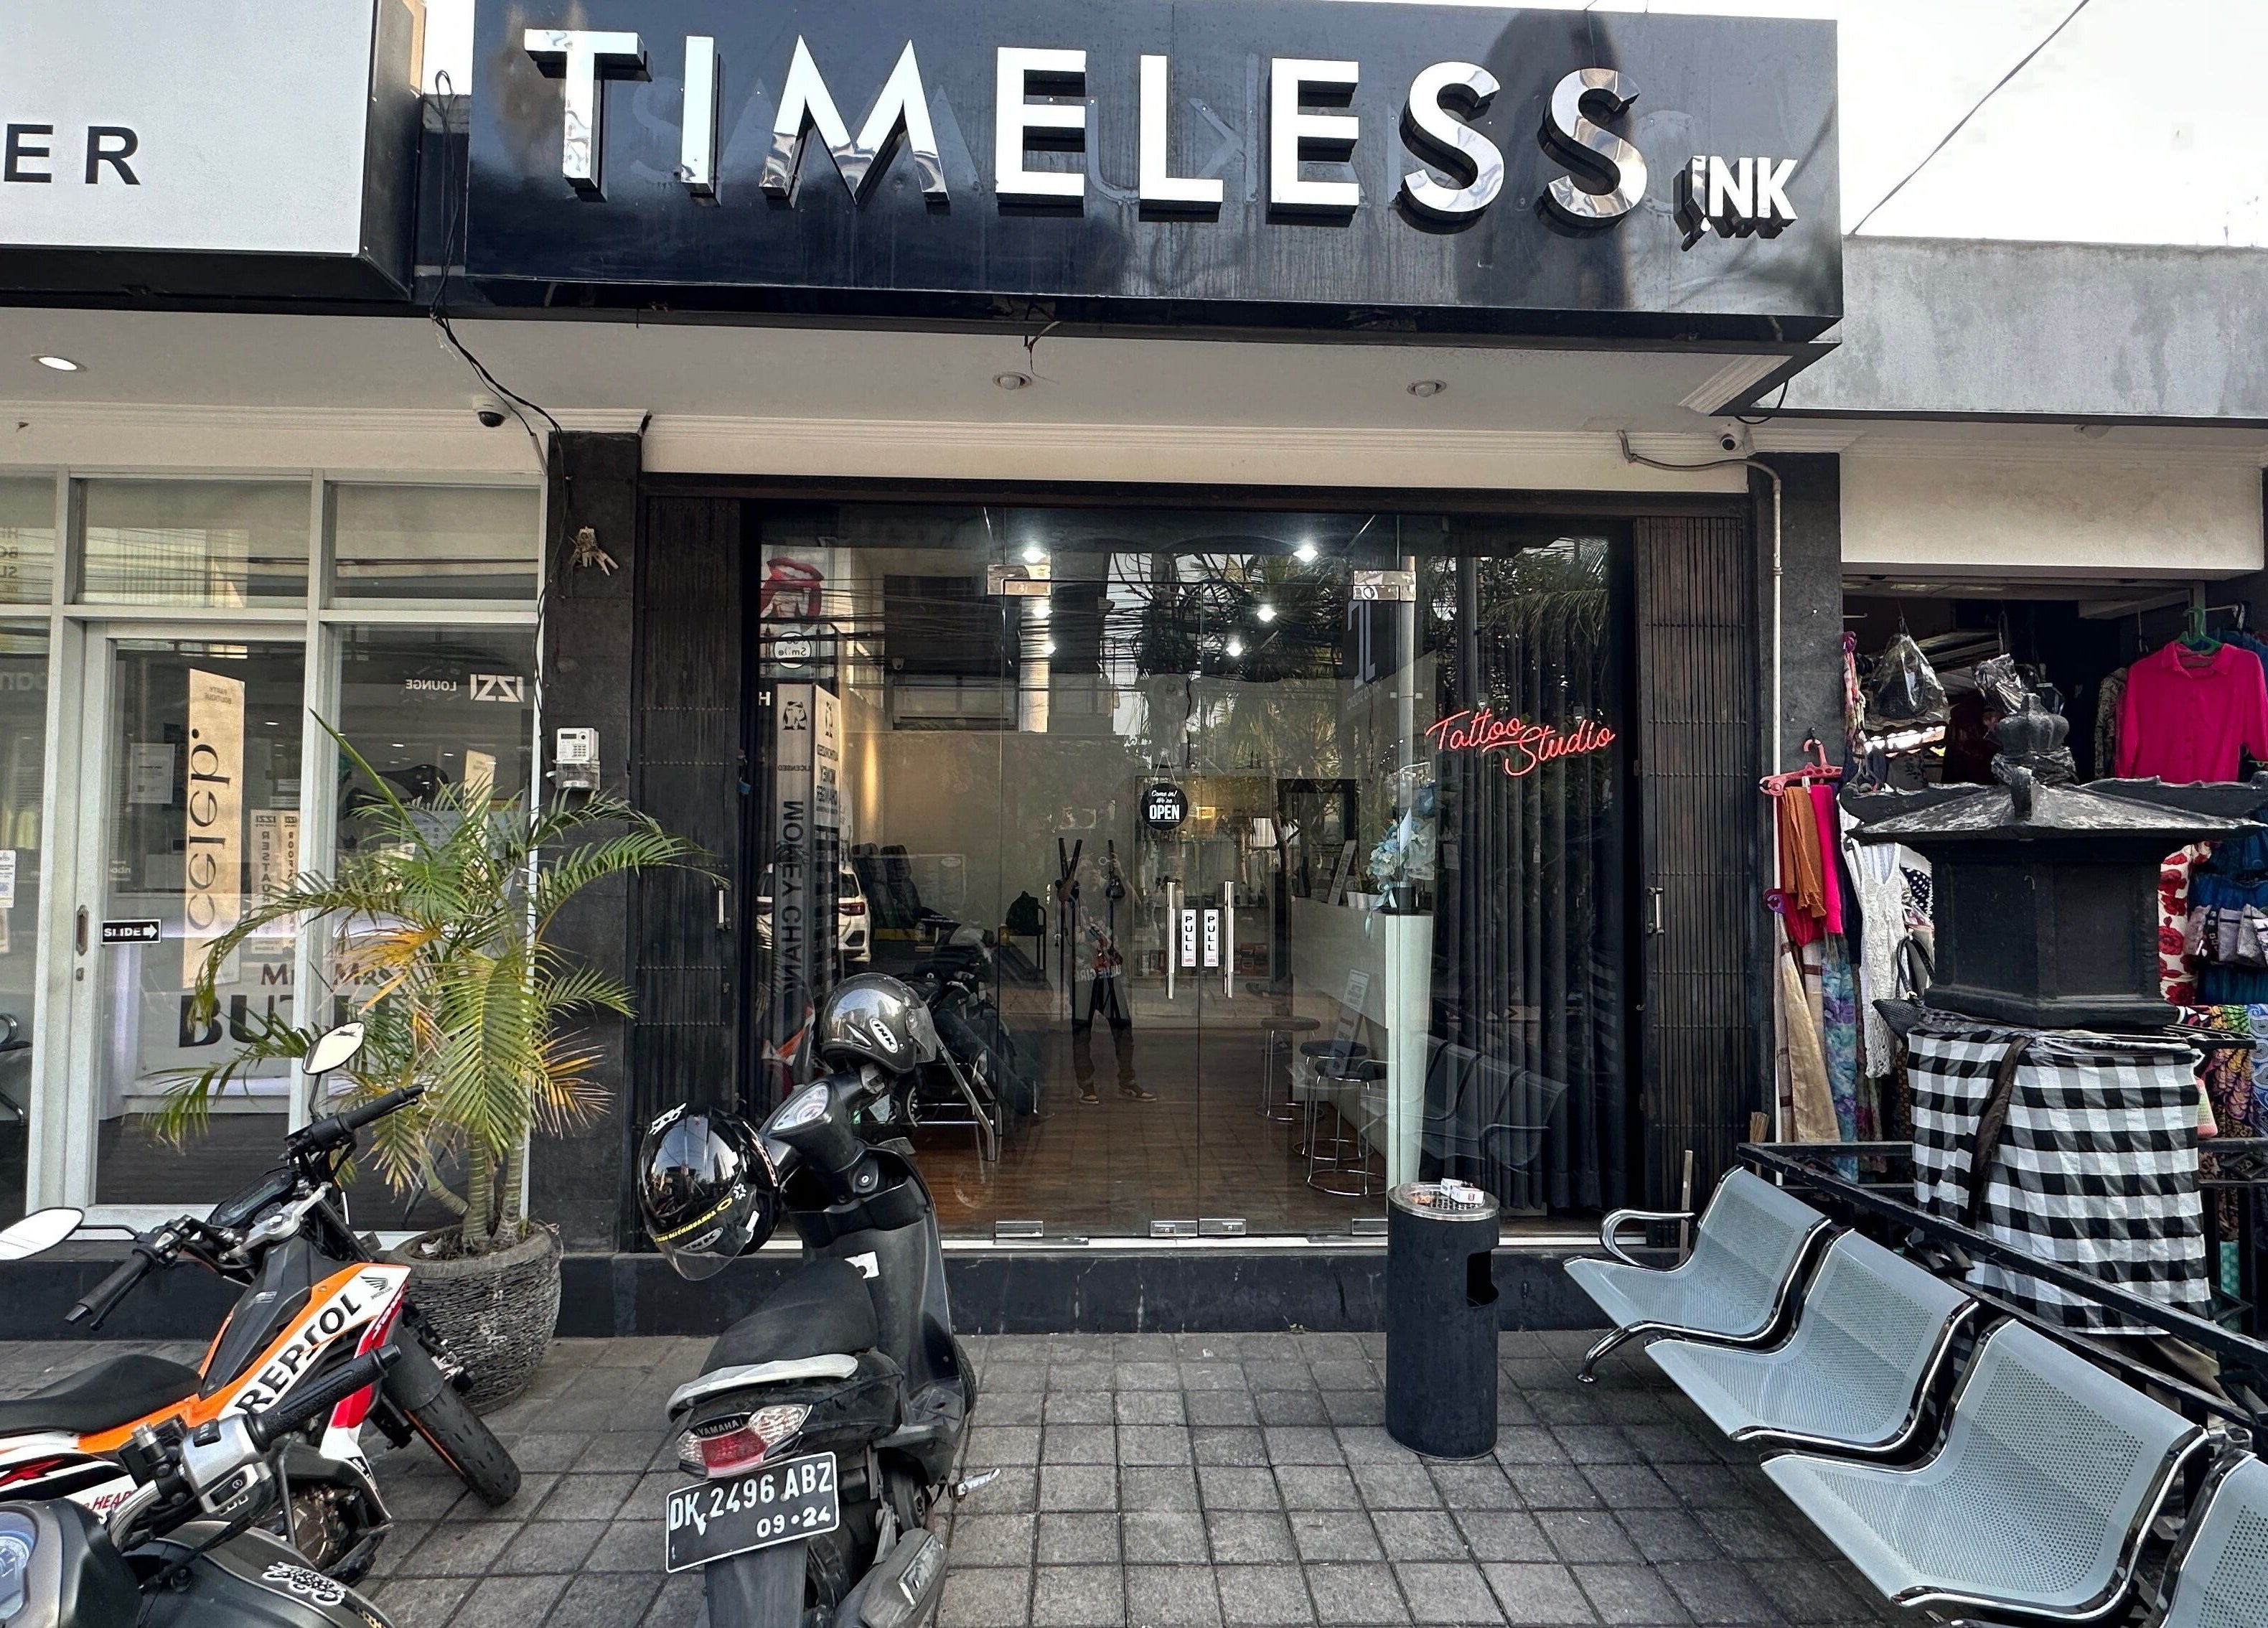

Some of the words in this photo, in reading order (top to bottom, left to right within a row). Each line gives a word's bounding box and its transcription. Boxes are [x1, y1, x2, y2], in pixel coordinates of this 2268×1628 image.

[3, 123, 141, 185] ER
[524, 29, 1649, 230] TIMELESS
[1425, 708, 1527, 752] Tattoo
[1504, 720, 1616, 777] Studio
[1149, 804, 1180, 820] OPEN
[104, 927, 141, 937] SLIDE
[873, 1020, 897, 1052] INK
[235, 1294, 362, 1414] REPSOL
[697, 1418, 740, 1438] YAMAHA
[669, 1491, 704, 1533] DK
[709, 1474, 774, 1519] 2496
[784, 1461, 833, 1502] ABZ
